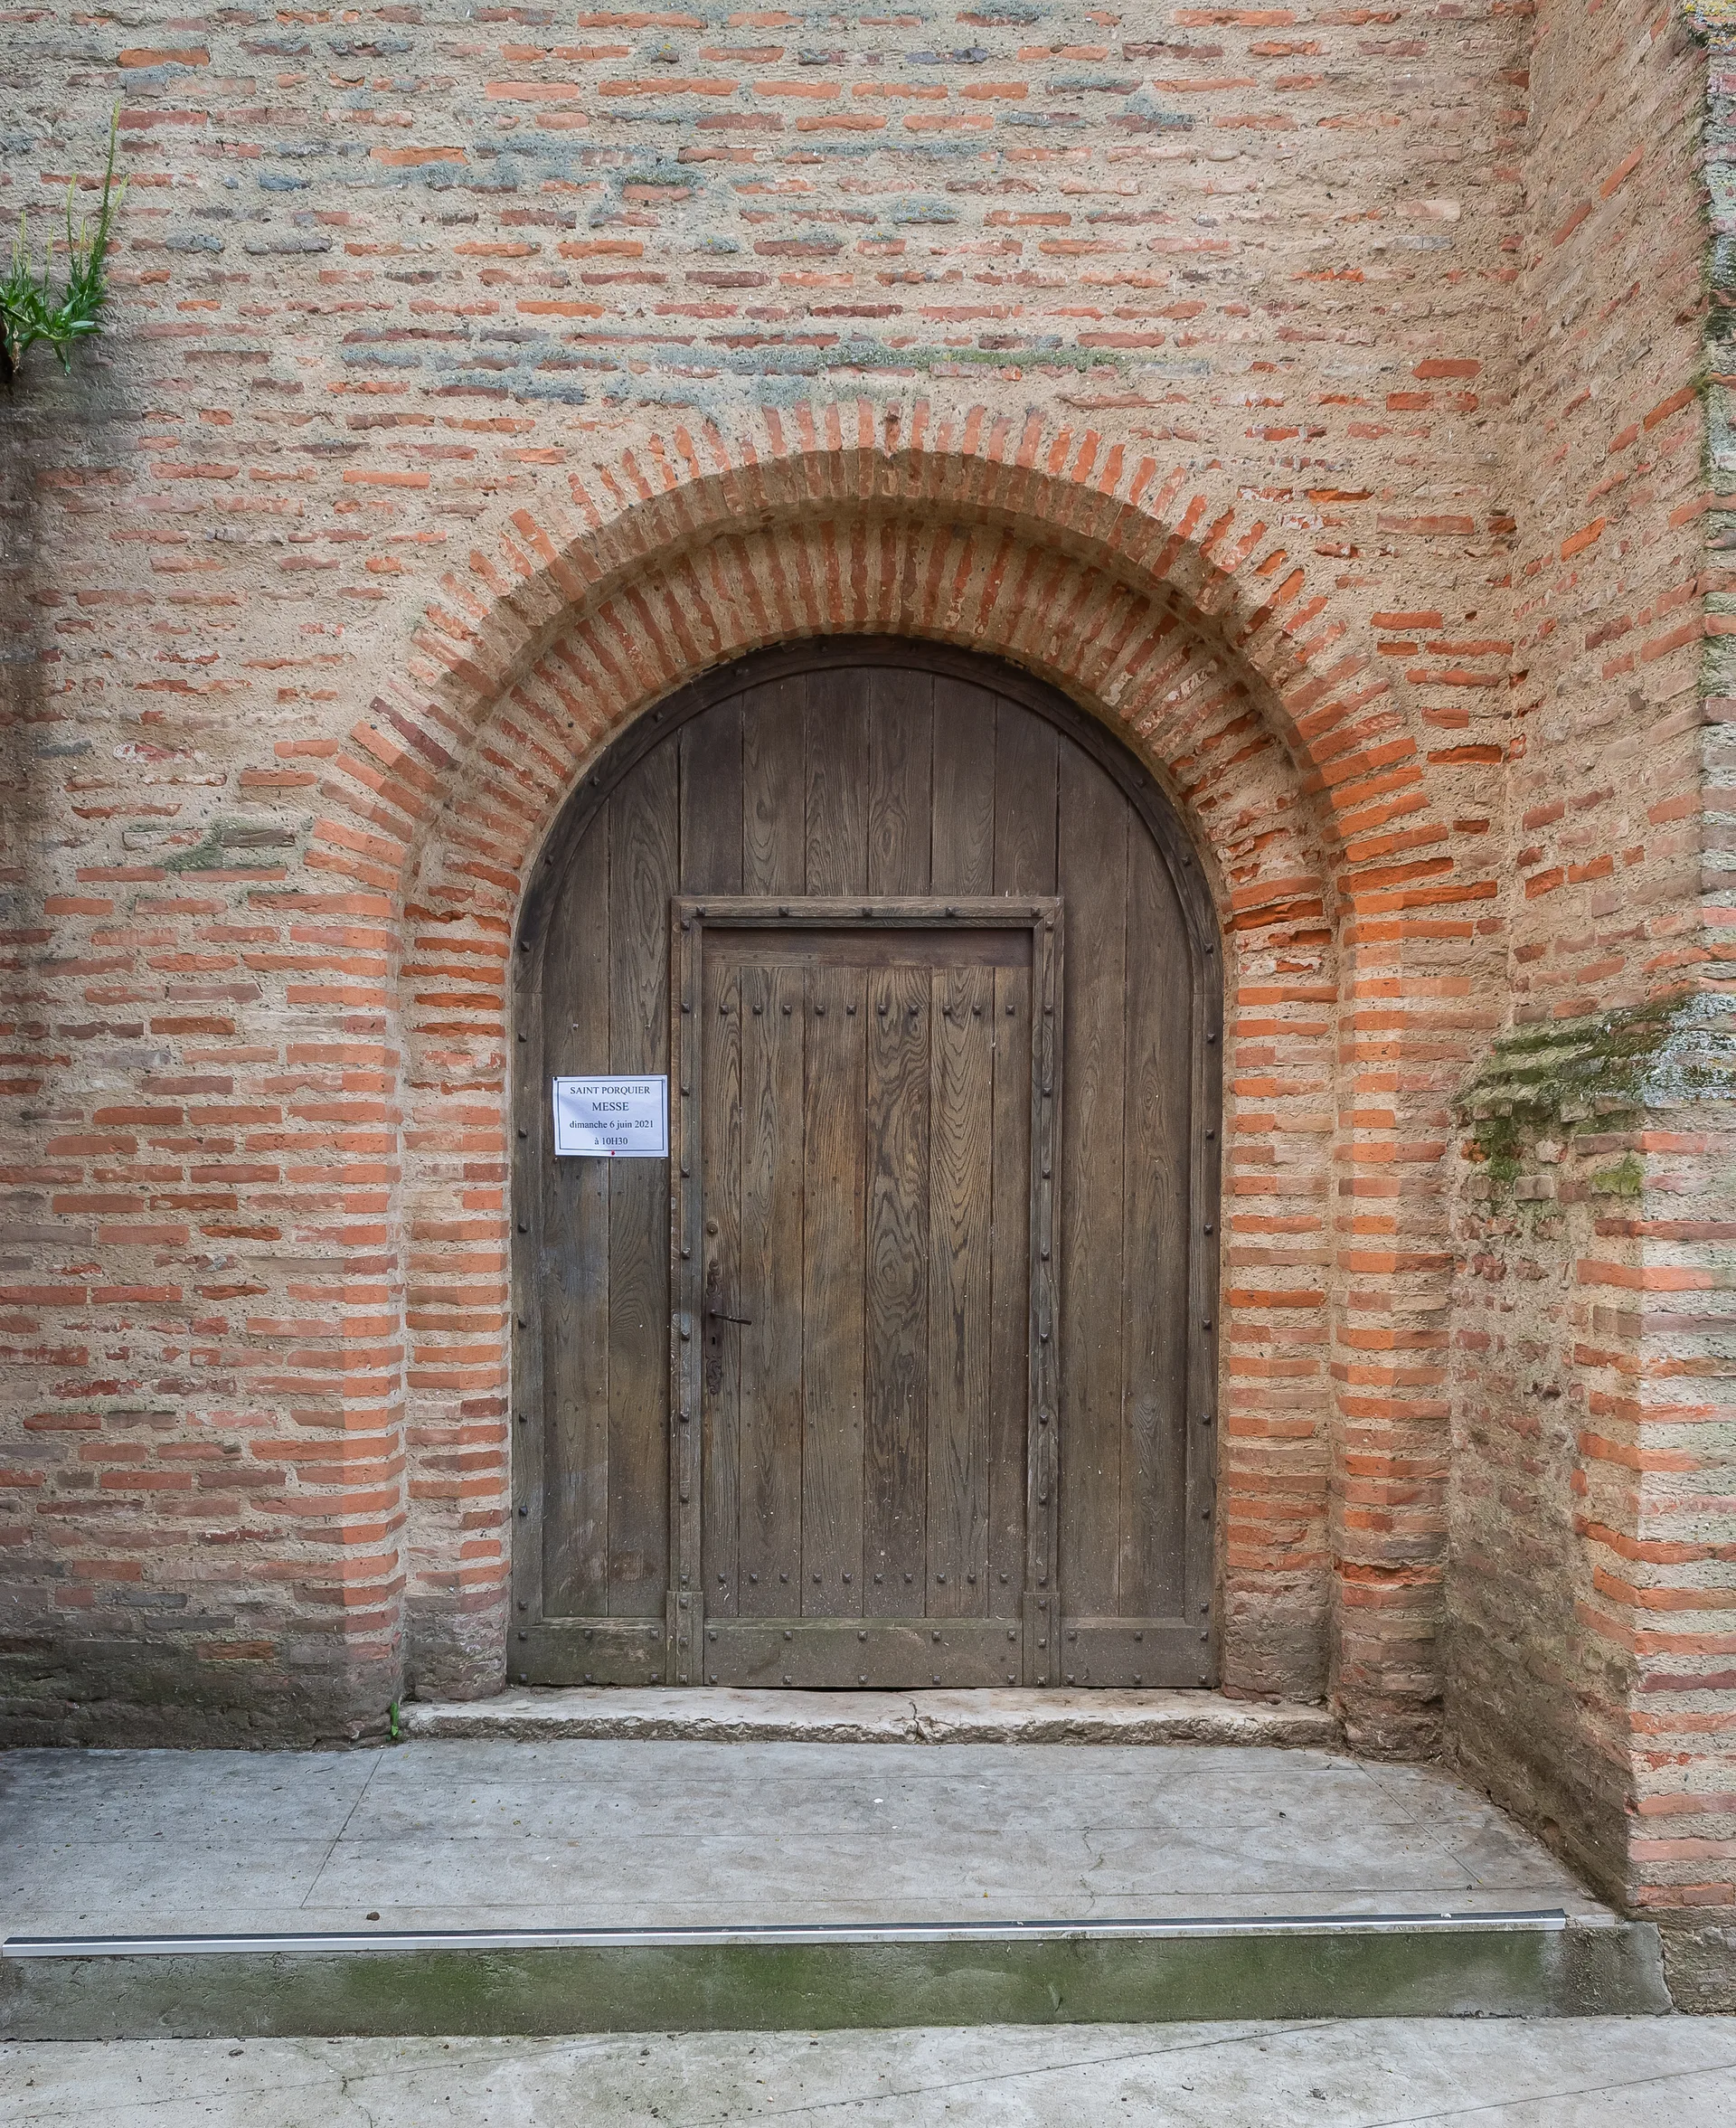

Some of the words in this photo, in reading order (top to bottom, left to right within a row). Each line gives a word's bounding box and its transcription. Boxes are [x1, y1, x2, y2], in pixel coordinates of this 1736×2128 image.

[570, 1086, 599, 1094] SAINT
[601, 1086, 650, 1095] PORQUIER
[592, 1102, 629, 1111] MESSE
[570, 1120, 608, 1129] dimanche
[609, 1121, 615, 1129] 6
[616, 1120, 632, 1130] juin
[635, 1120, 654, 1128] 2021
[594, 1137, 599, 1145] à
[602, 1137, 628, 1145] 10H30
